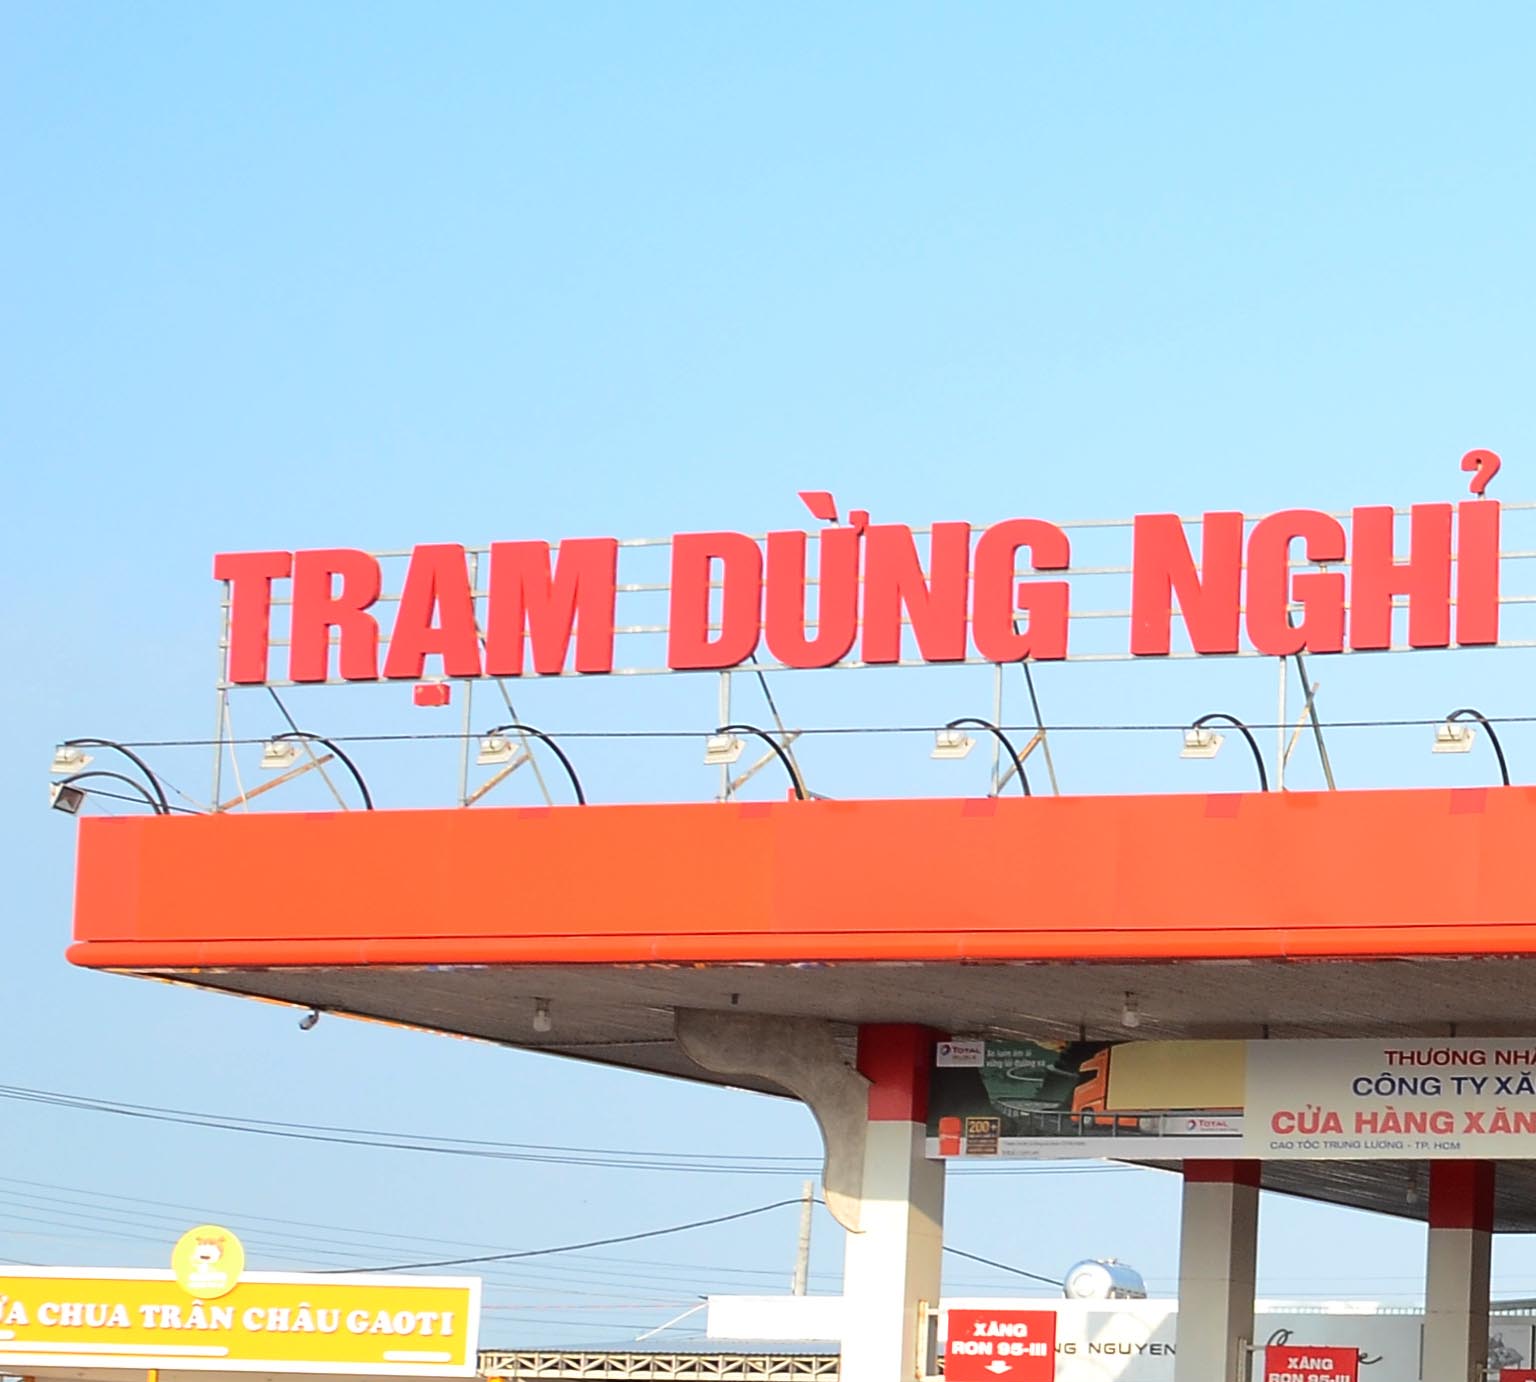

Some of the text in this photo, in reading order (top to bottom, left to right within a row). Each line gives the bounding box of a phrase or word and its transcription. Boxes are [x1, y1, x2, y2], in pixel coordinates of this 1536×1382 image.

[213, 537, 620, 707] TRẠM
[667, 490, 1072, 672] DỪNG
[1130, 448, 1502, 657] NGHỈ
[1384, 1047, 1486, 1066] THƯƠNG
[1352, 1072, 1441, 1096] CÔNG
[1450, 1076, 1488, 1095] TY
[1270, 1103, 1343, 1135] CỬA
[1354, 1105, 1455, 1134] HÀNG
[1270, 1141, 1294, 1150] CAO
[1323, 1140, 1361, 1150] TRUNG
[1434, 1141, 1461, 1150] HCM
[37, 1301, 131, 1328] CHUA
[139, 1299, 236, 1331] TRÂN
[242, 1302, 341, 1334] CHÂU
[346, 1311, 456, 1336] GAOTI
[951, 1341, 1047, 1357] RON 95-III
